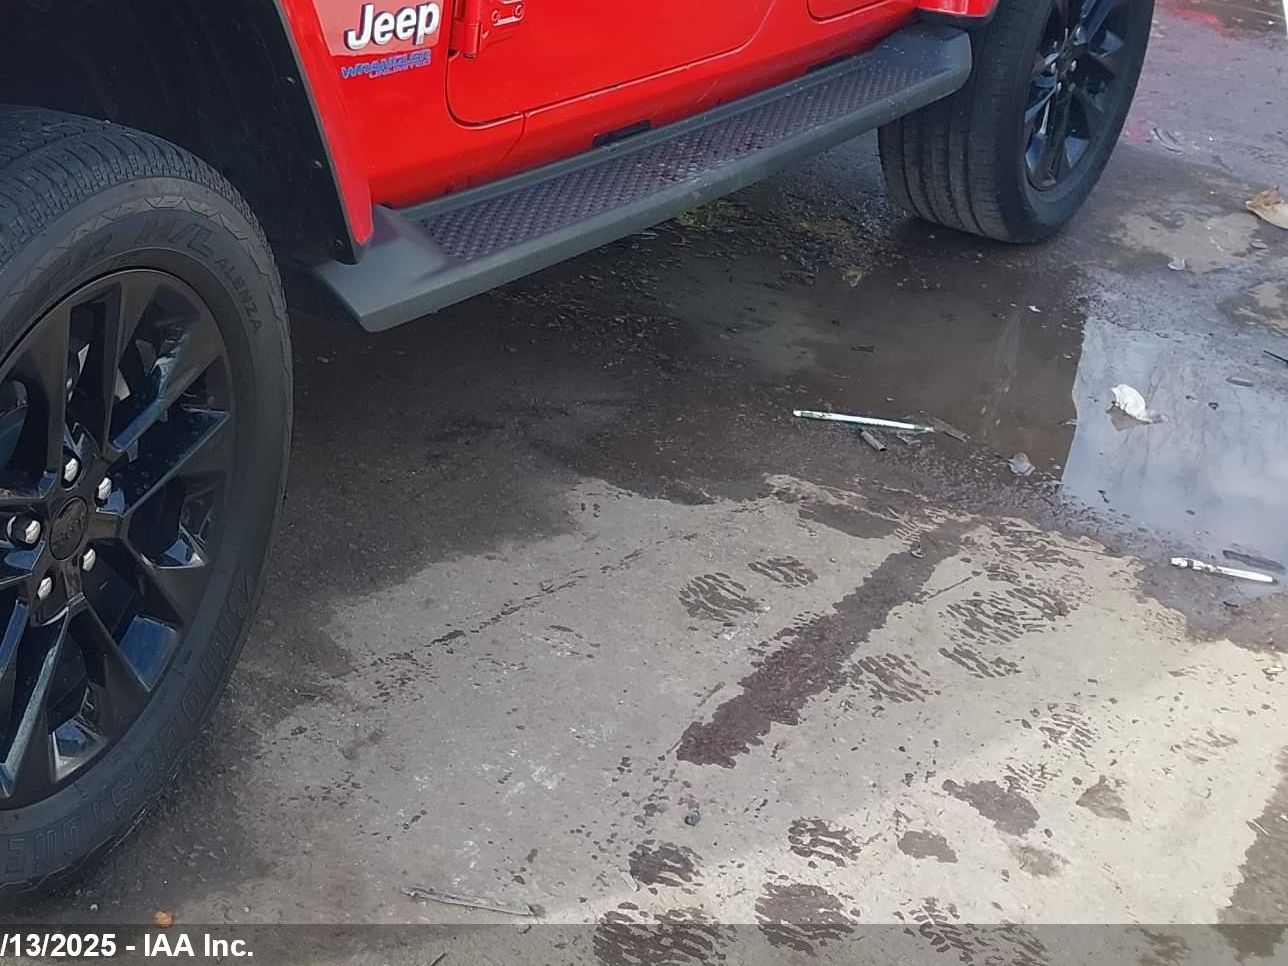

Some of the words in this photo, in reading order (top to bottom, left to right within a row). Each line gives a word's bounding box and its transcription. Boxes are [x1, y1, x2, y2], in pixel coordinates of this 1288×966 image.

[344, 1, 441, 51] Jeep
[341, 49, 431, 79] WRANGLER
[214, 257, 263, 334] ALENZA
